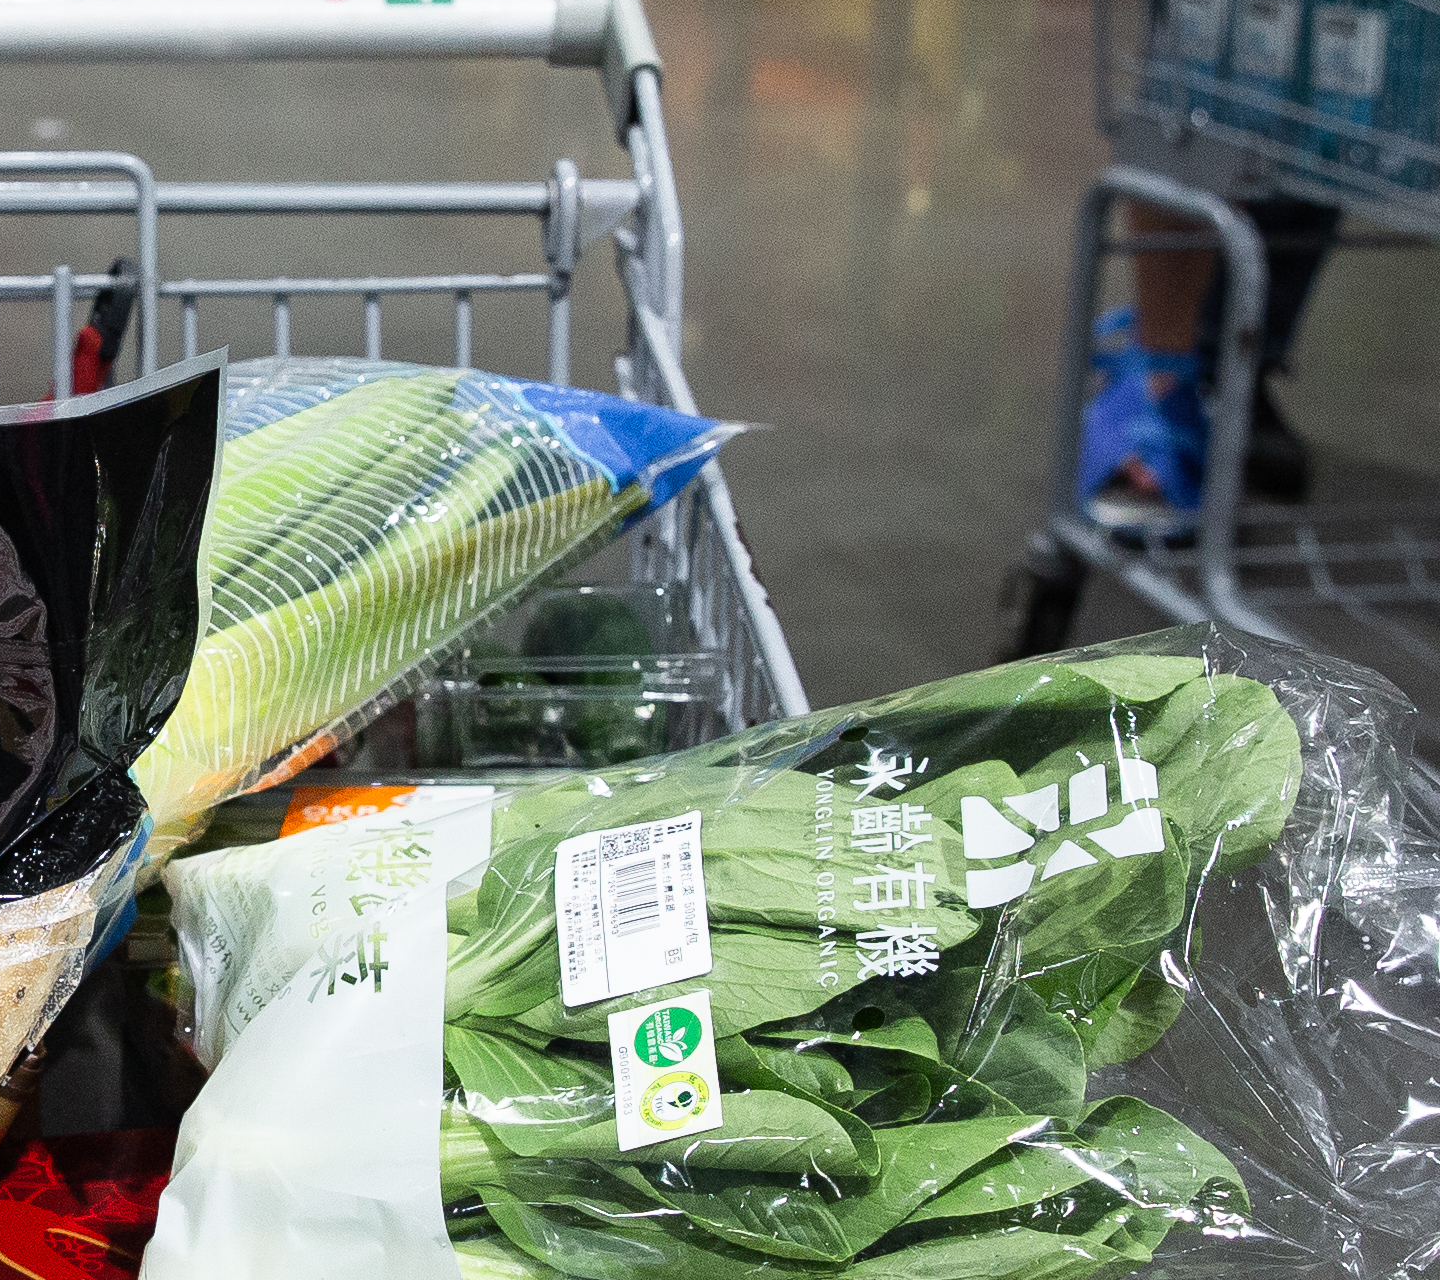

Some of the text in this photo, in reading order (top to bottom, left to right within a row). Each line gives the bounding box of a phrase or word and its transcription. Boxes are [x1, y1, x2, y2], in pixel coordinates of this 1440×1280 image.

[815, 768, 839, 989] YONGLIN ORGANIC
[849, 747, 940, 982] 永齡有機
[654, 1011, 664, 1044] ORGANIC
[662, 1009, 672, 1043] TAIWAN
[617, 1045, 633, 1116] G900611383
[654, 1096, 663, 1115] TOC
